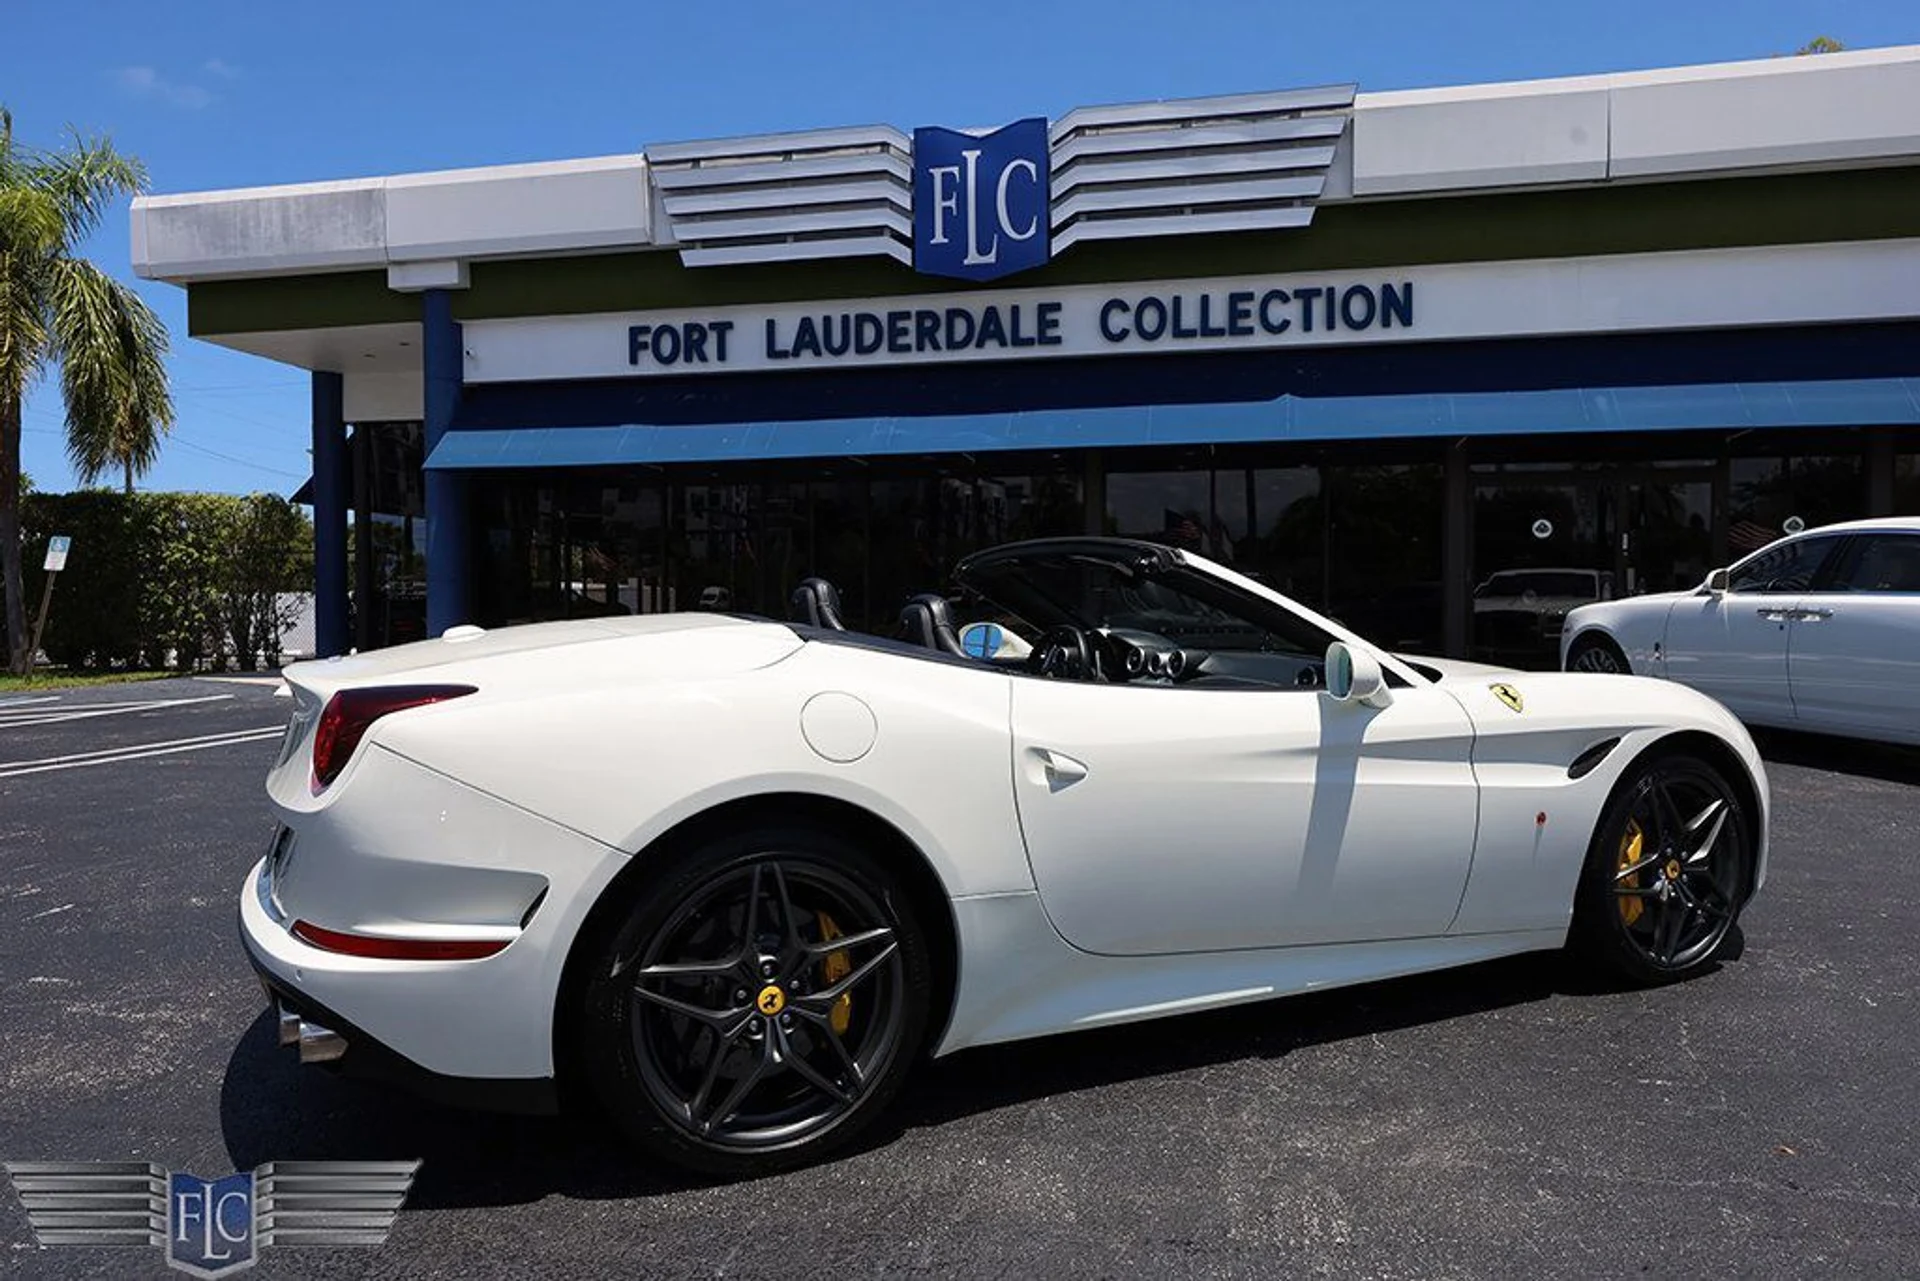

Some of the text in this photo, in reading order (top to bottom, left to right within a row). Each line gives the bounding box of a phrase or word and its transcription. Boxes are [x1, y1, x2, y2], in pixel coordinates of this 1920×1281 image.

[929, 150, 1037, 266] FLC
[628, 282, 1414, 365] FORT LAUDERDALE COLLECTION
